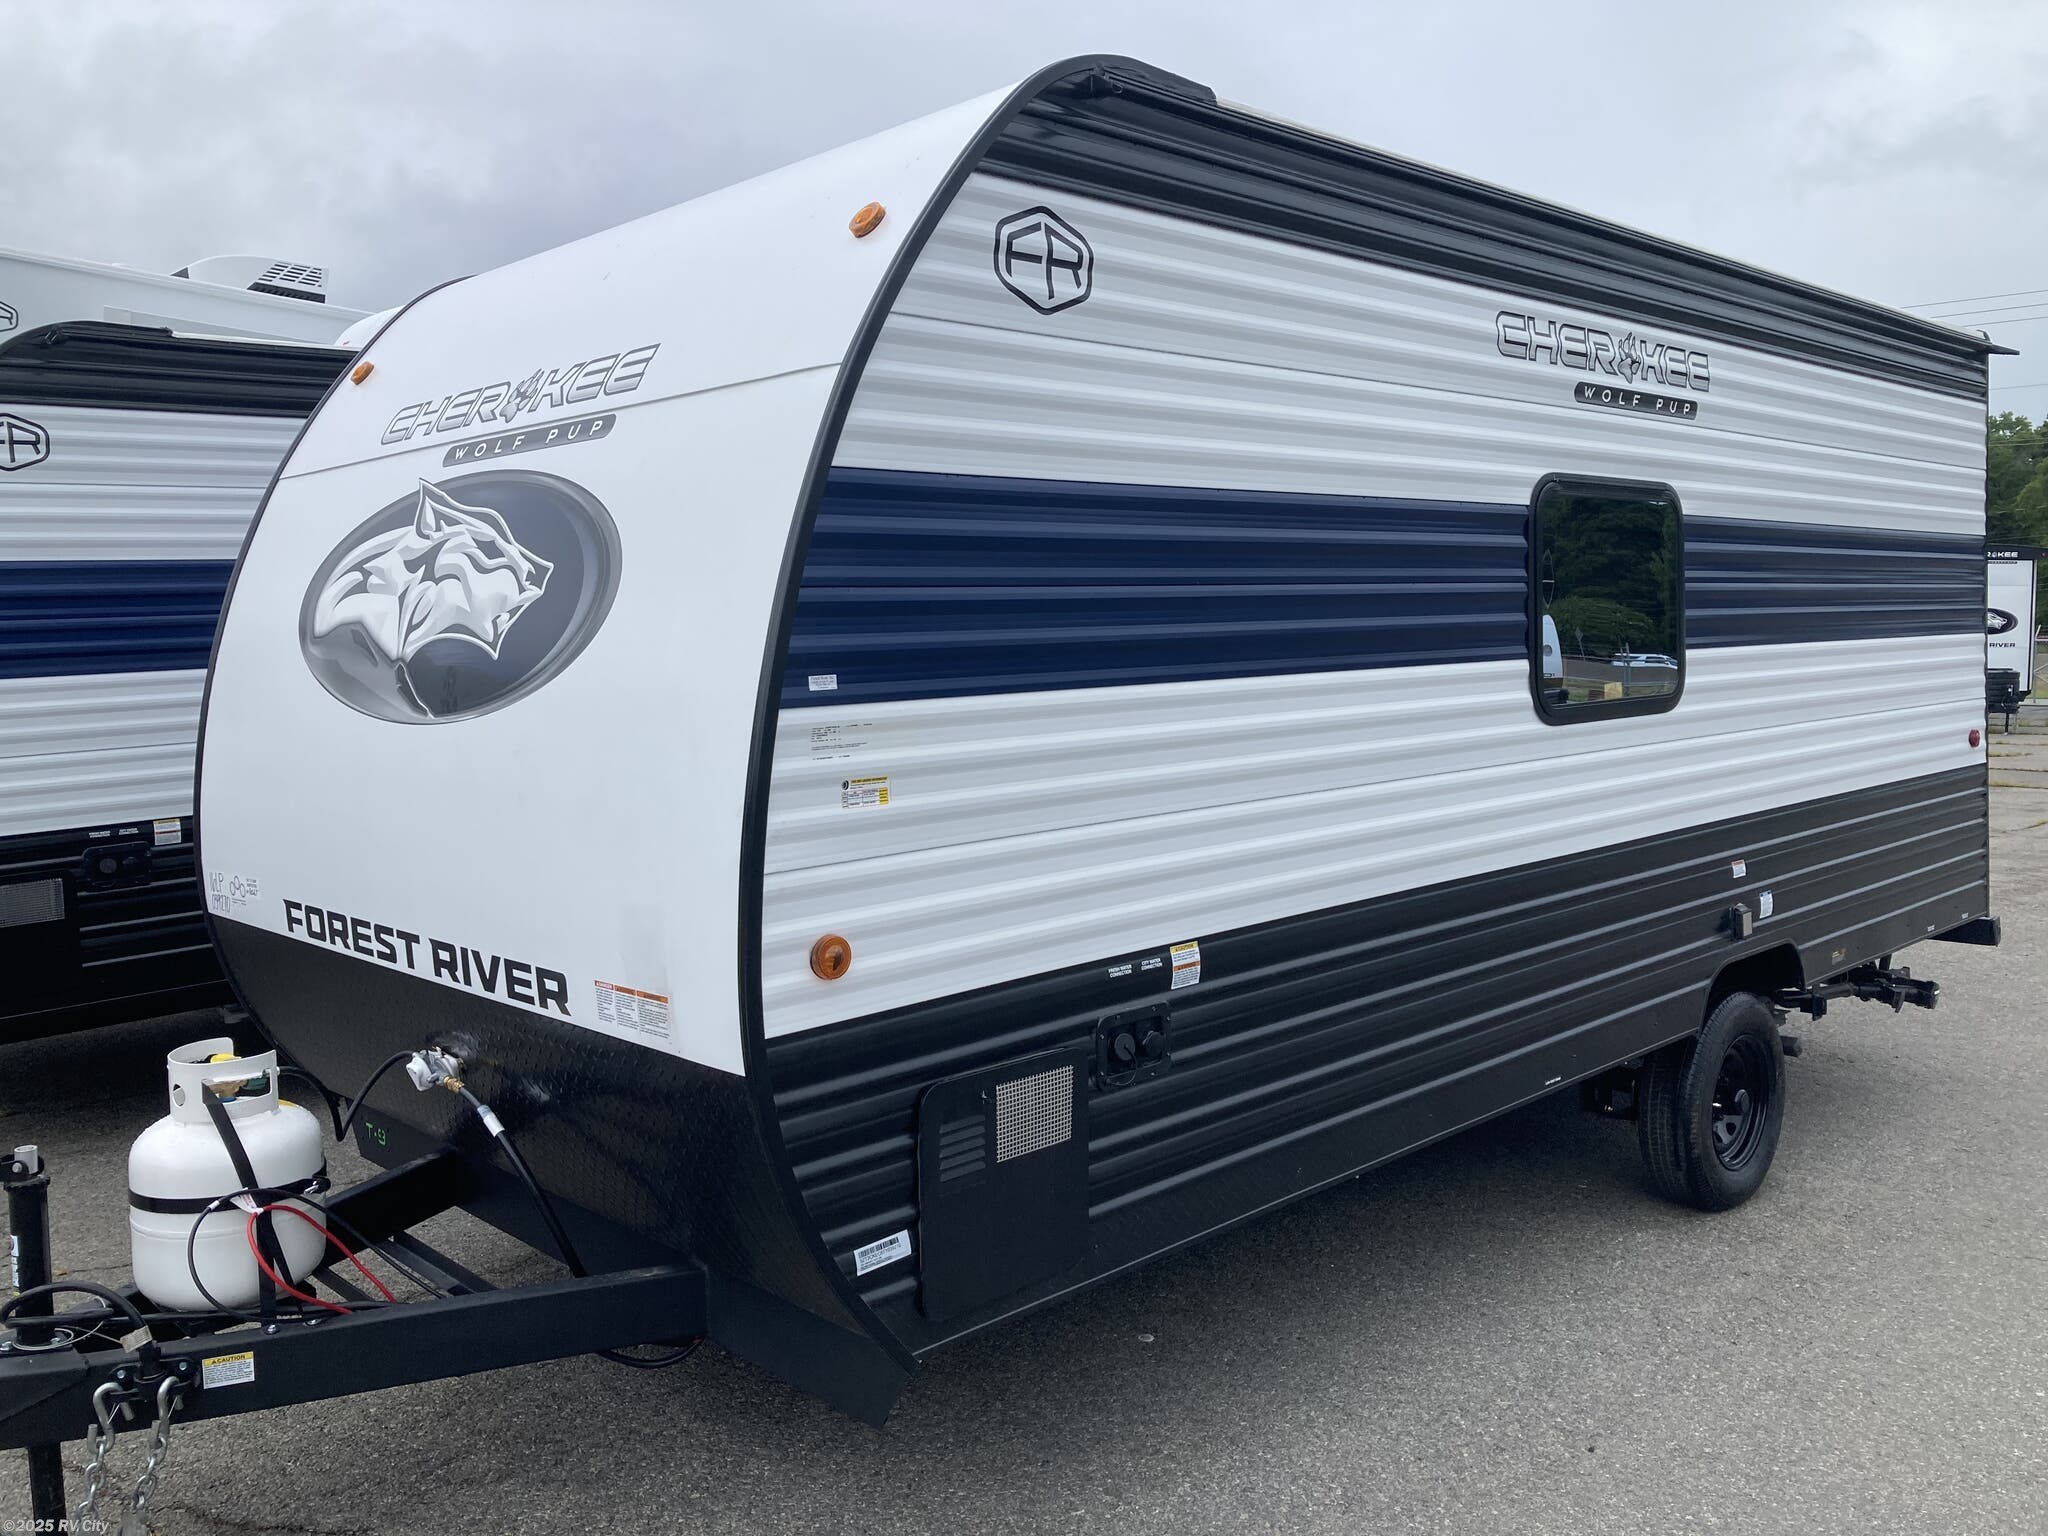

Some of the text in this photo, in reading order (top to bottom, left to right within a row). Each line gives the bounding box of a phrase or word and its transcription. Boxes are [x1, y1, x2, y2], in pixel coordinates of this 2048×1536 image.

[1584, 385, 1691, 415] WOLF PUP
[454, 420, 603, 460] WOLF PUP
[283, 899, 421, 970] FOREST
[428, 937, 572, 1017] RIVER
[216, 1355, 246, 1363] CAUTION
